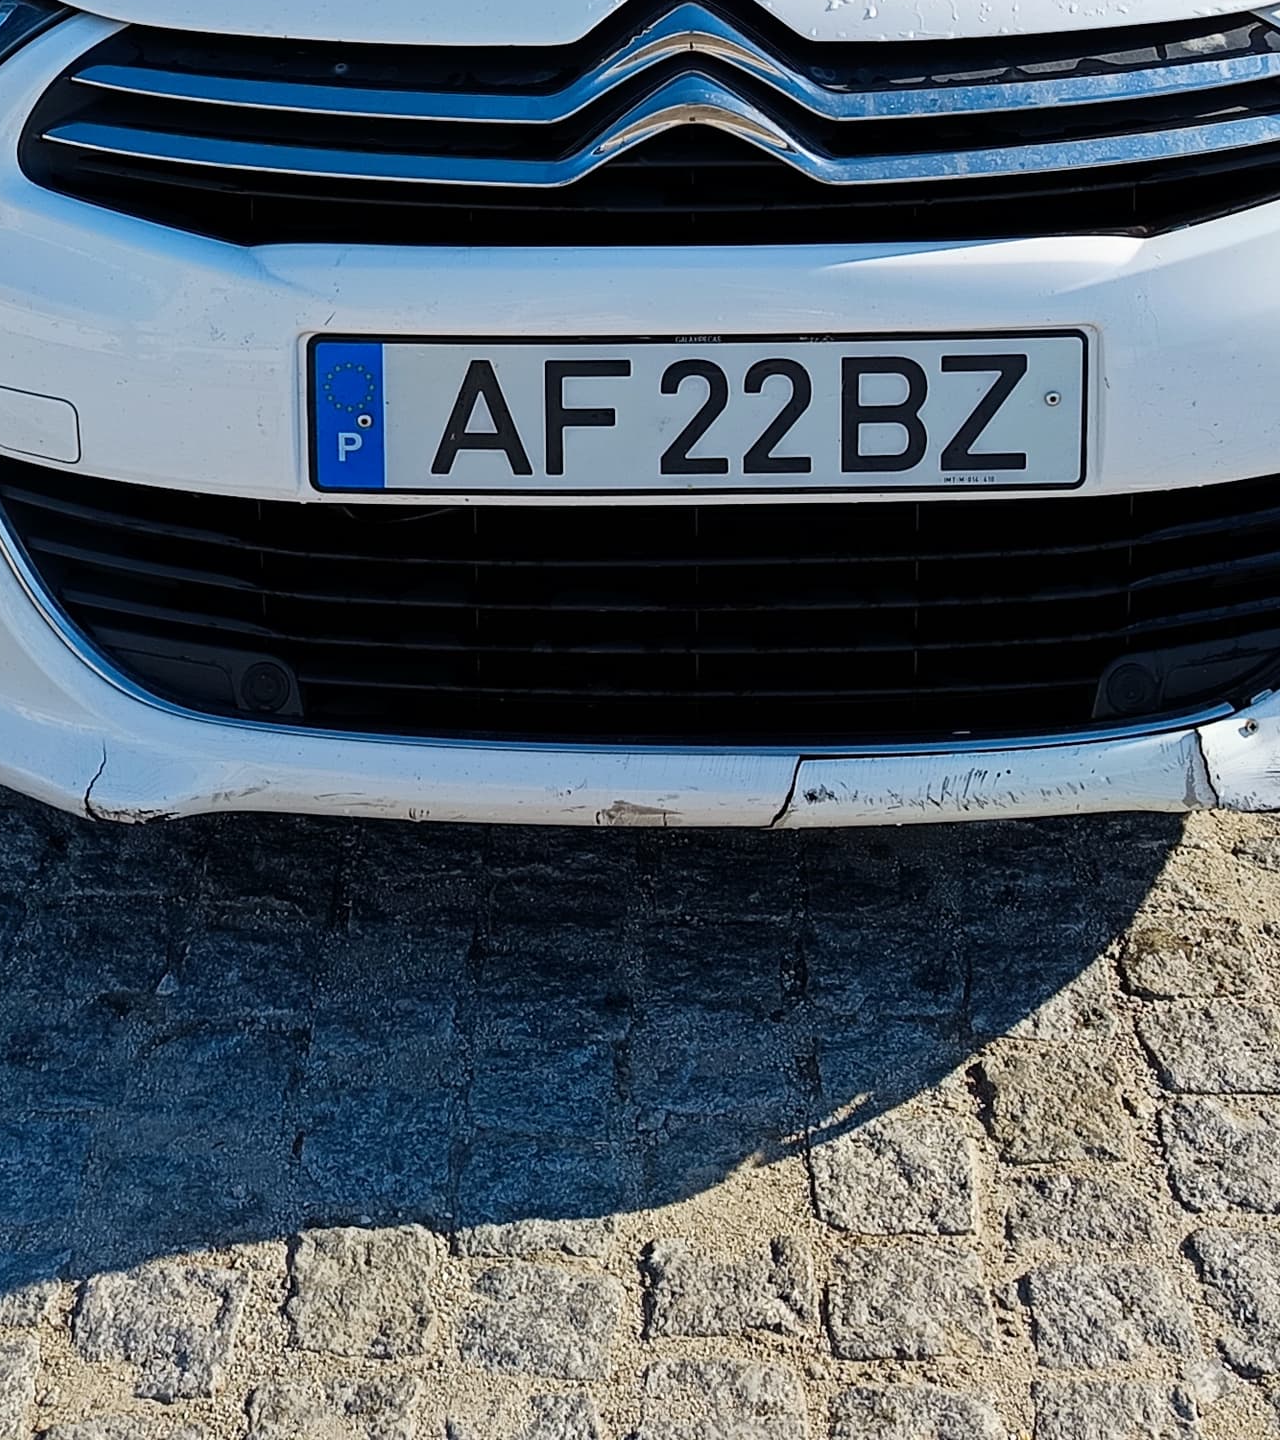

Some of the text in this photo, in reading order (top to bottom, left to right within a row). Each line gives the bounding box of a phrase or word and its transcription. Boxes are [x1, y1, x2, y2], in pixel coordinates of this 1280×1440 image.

[337, 431, 363, 462] P
[430, 354, 1028, 476] AF 22 BZ
